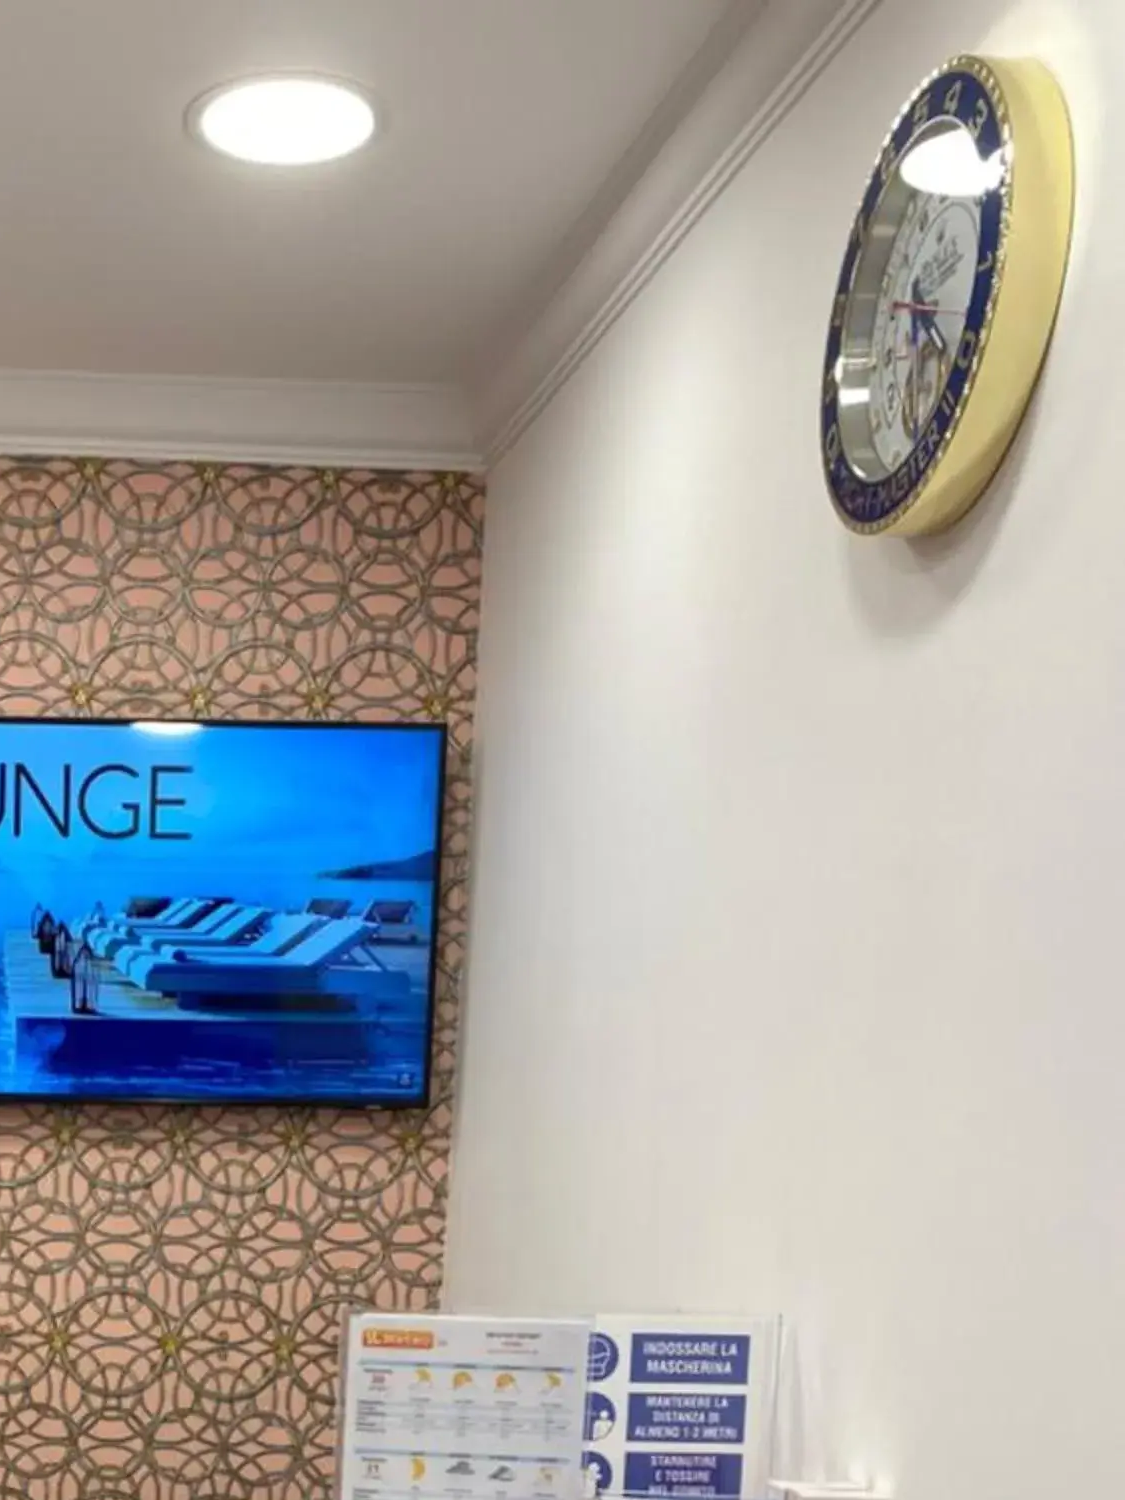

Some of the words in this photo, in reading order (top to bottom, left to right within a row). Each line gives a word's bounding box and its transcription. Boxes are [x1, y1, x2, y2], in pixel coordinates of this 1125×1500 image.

[643, 1340, 719, 1356] INDOSSARE
[722, 1342, 739, 1357] LA
[646, 1359, 733, 1374] MASCHERINA
[715, 1397, 730, 1408] LA
